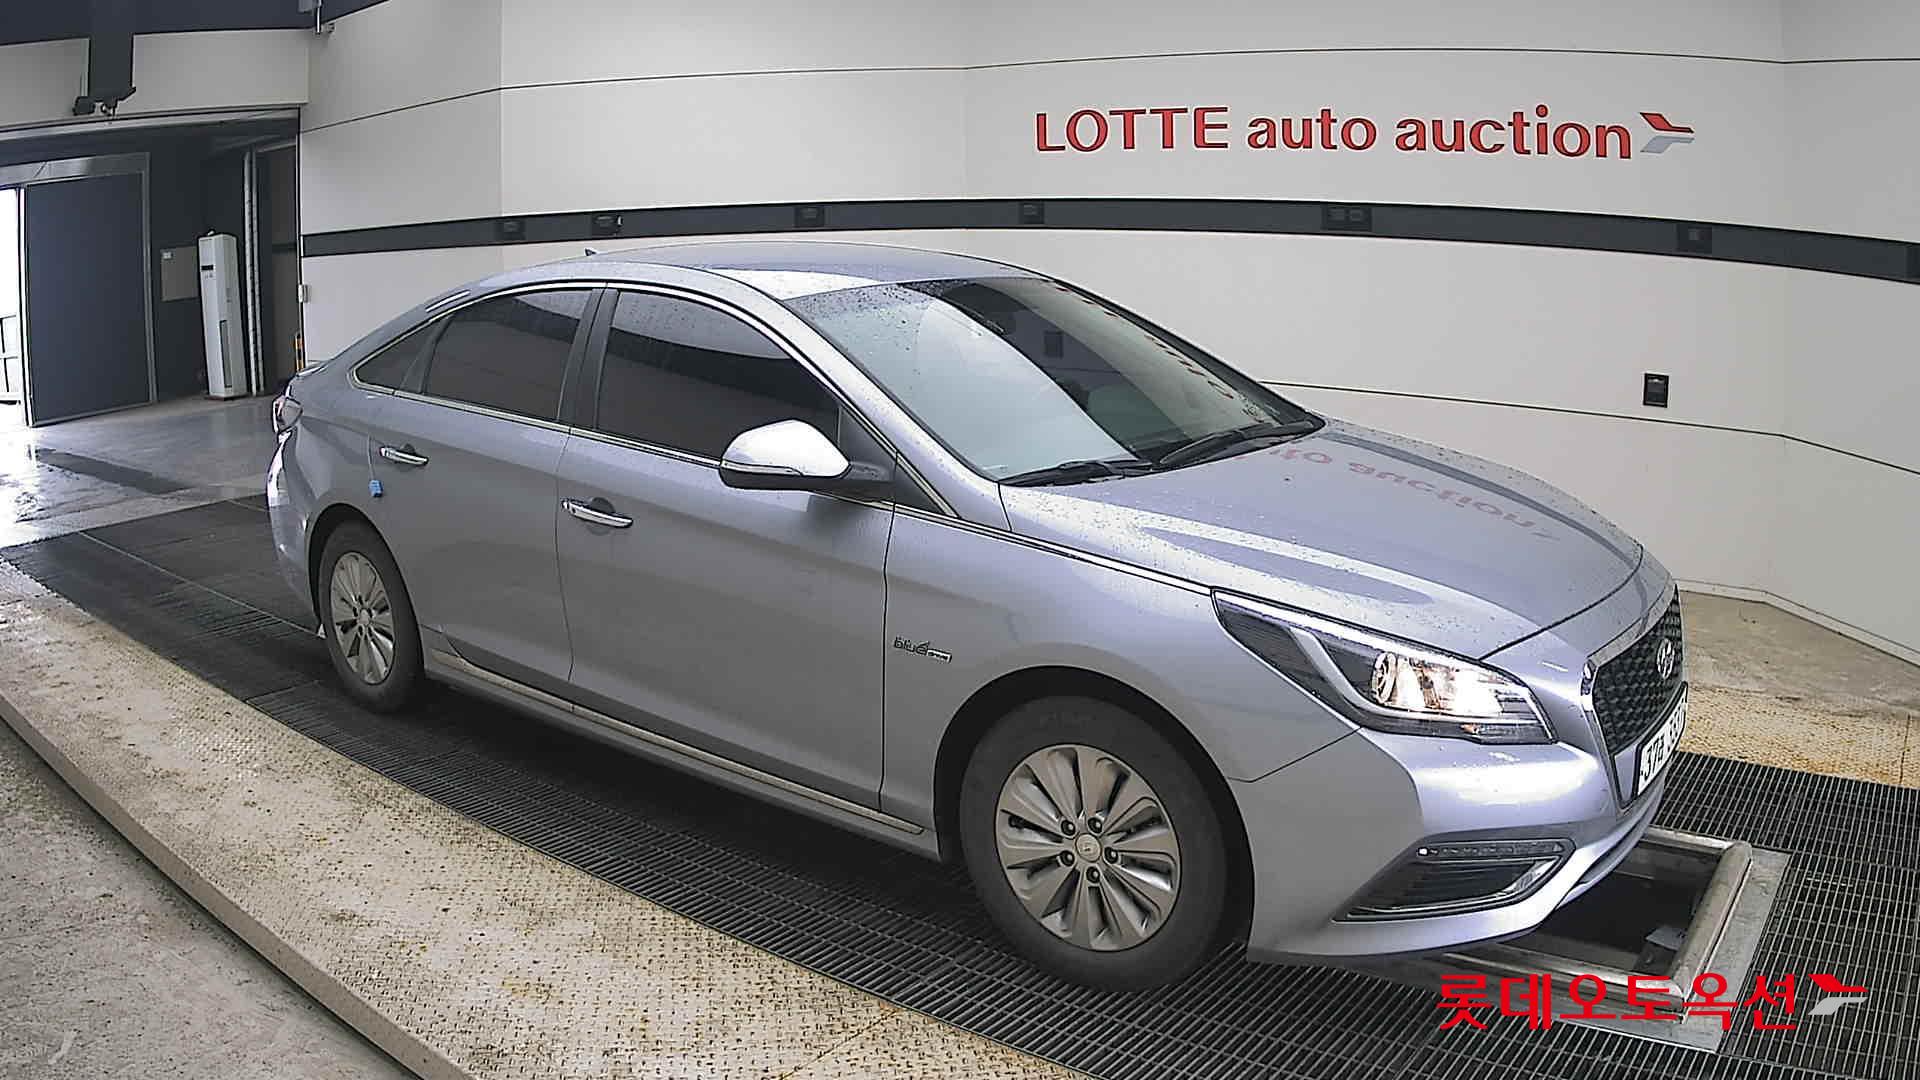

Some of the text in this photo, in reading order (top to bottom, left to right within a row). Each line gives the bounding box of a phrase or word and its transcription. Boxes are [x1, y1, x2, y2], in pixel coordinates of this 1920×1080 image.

[1036, 104, 1632, 159] LOTTE auto auction
